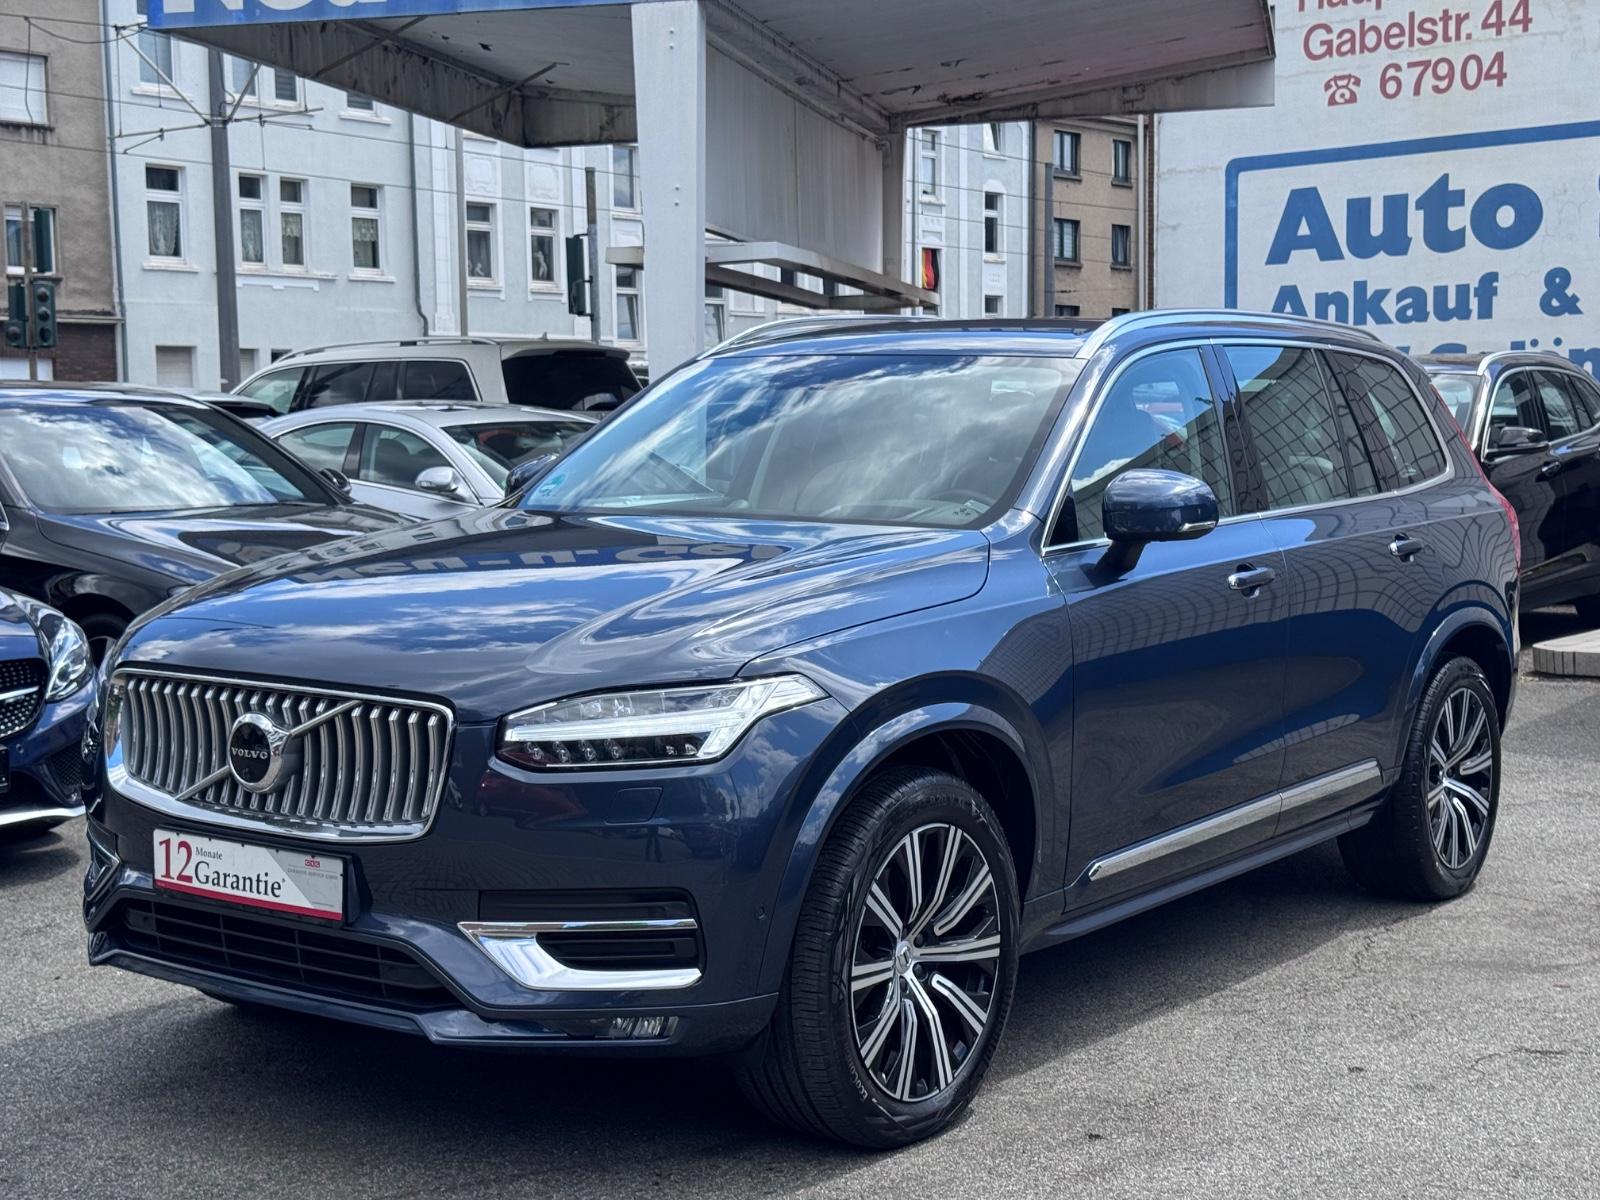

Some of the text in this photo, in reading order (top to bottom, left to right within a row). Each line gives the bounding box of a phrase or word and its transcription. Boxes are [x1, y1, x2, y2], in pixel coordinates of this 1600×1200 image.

[1303, 0, 1533, 61] Gabelstr. 44
[1379, 51, 1507, 100] 67904
[1264, 172, 1544, 266] Auto
[1270, 266, 1584, 327] Ankauf &
[231, 746, 268, 760] VOLVO
[158, 837, 223, 884] 12 Monate
